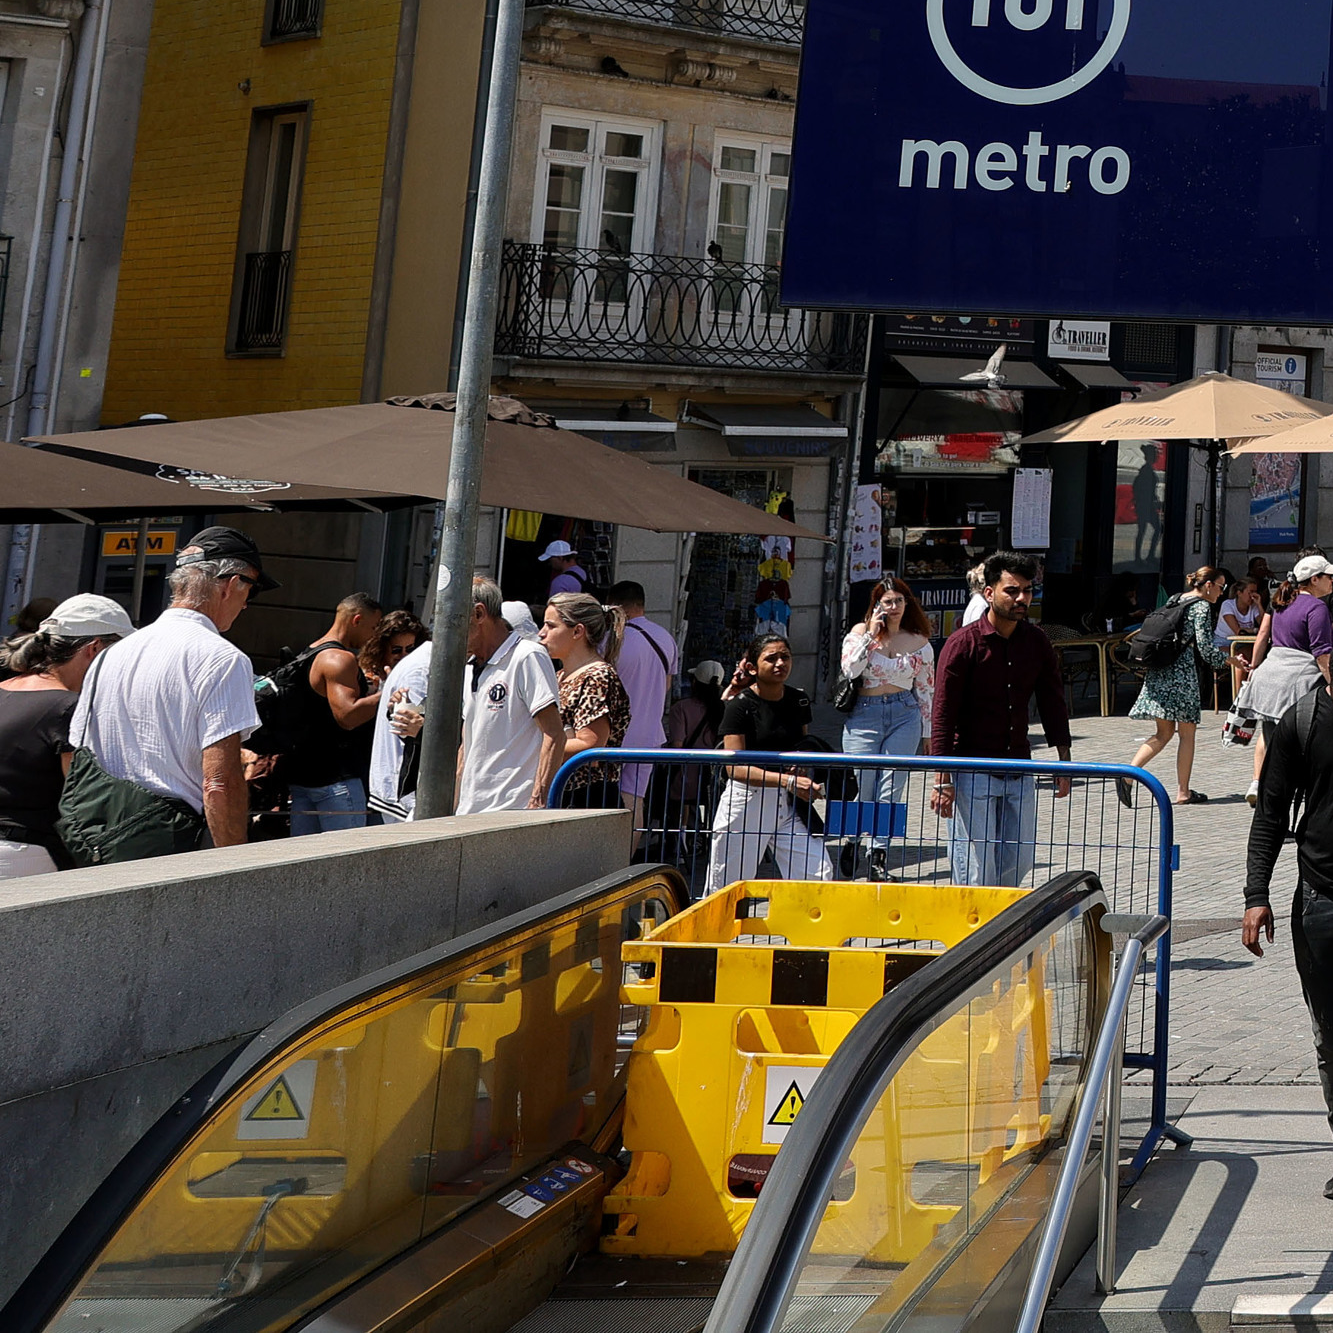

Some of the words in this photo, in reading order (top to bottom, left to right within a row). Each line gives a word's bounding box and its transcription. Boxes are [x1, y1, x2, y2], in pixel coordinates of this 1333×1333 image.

[898, 131, 1132, 195] metro
[1067, 329, 1107, 346] TRAVELLER
[1257, 357, 1282, 366] OFFICIAL
[1257, 364, 1282, 373] TOURISM
[744, 440, 831, 454] SOUVENIRS
[920, 589, 966, 605] TRAVELLER
